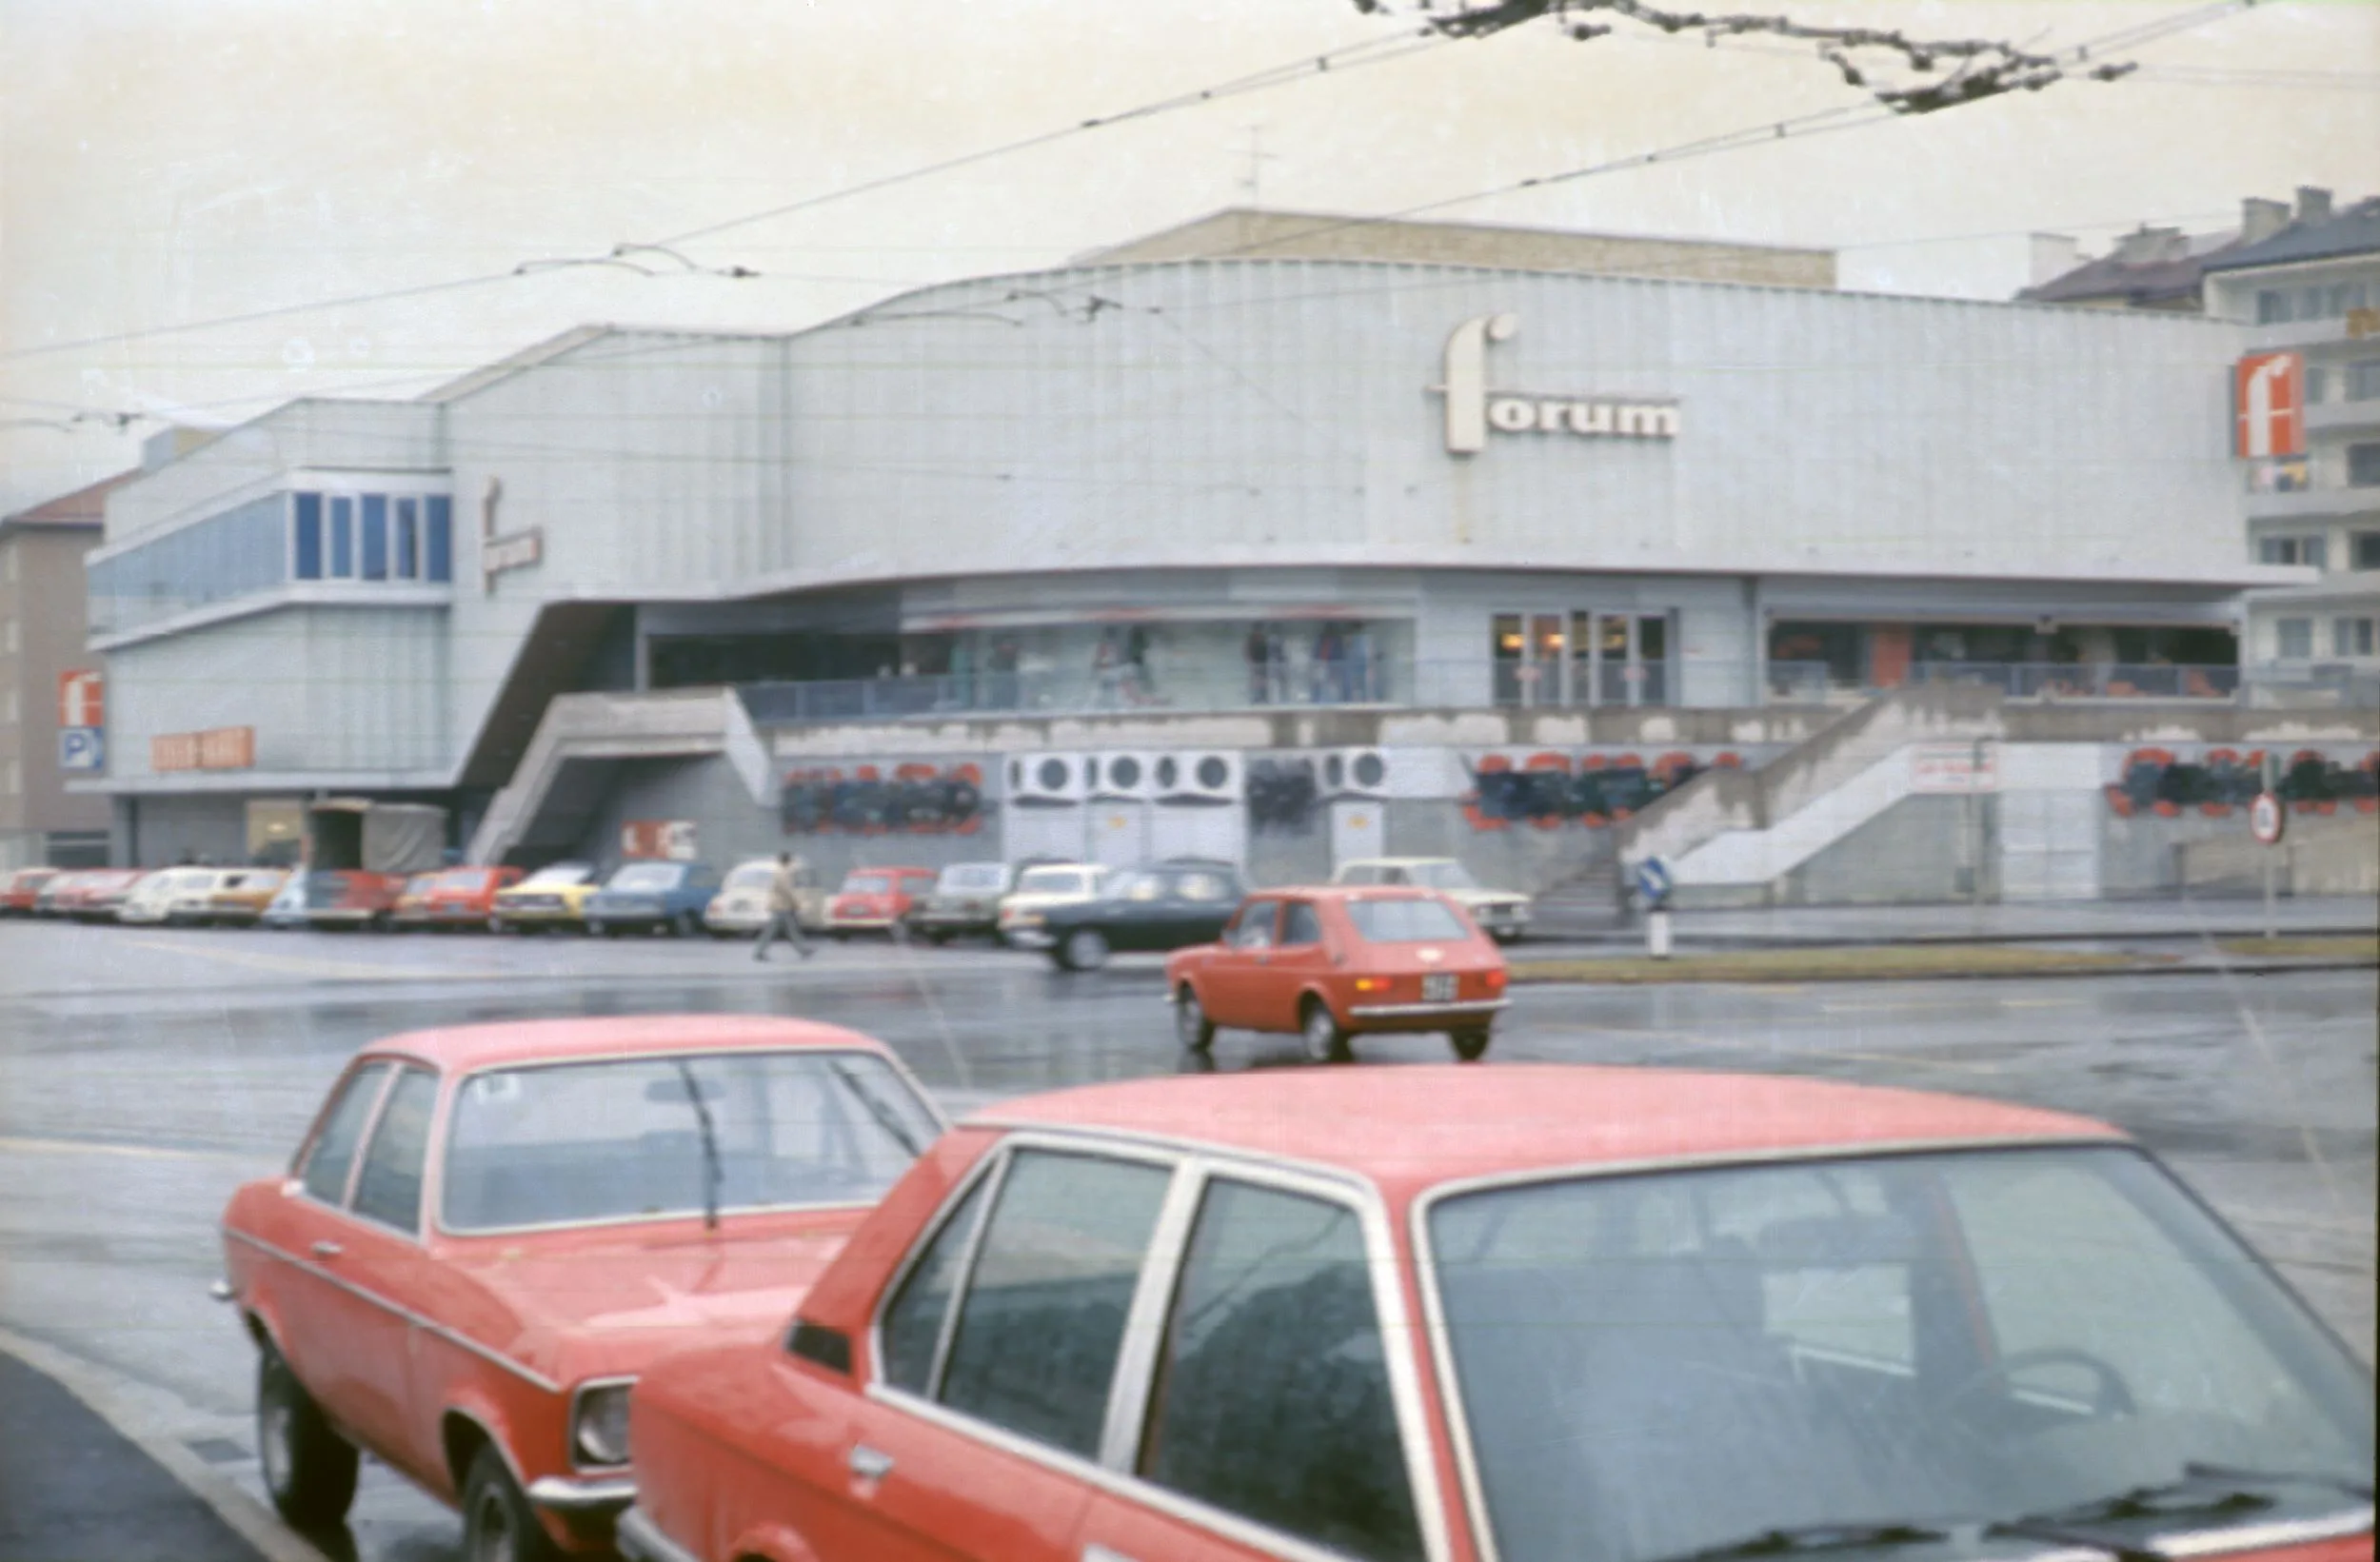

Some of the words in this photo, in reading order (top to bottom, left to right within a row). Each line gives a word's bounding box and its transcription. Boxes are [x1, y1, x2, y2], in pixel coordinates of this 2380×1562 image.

[1423, 313, 1680, 452] forum
[2237, 355, 2291, 456] f
[64, 732, 87, 761] P
